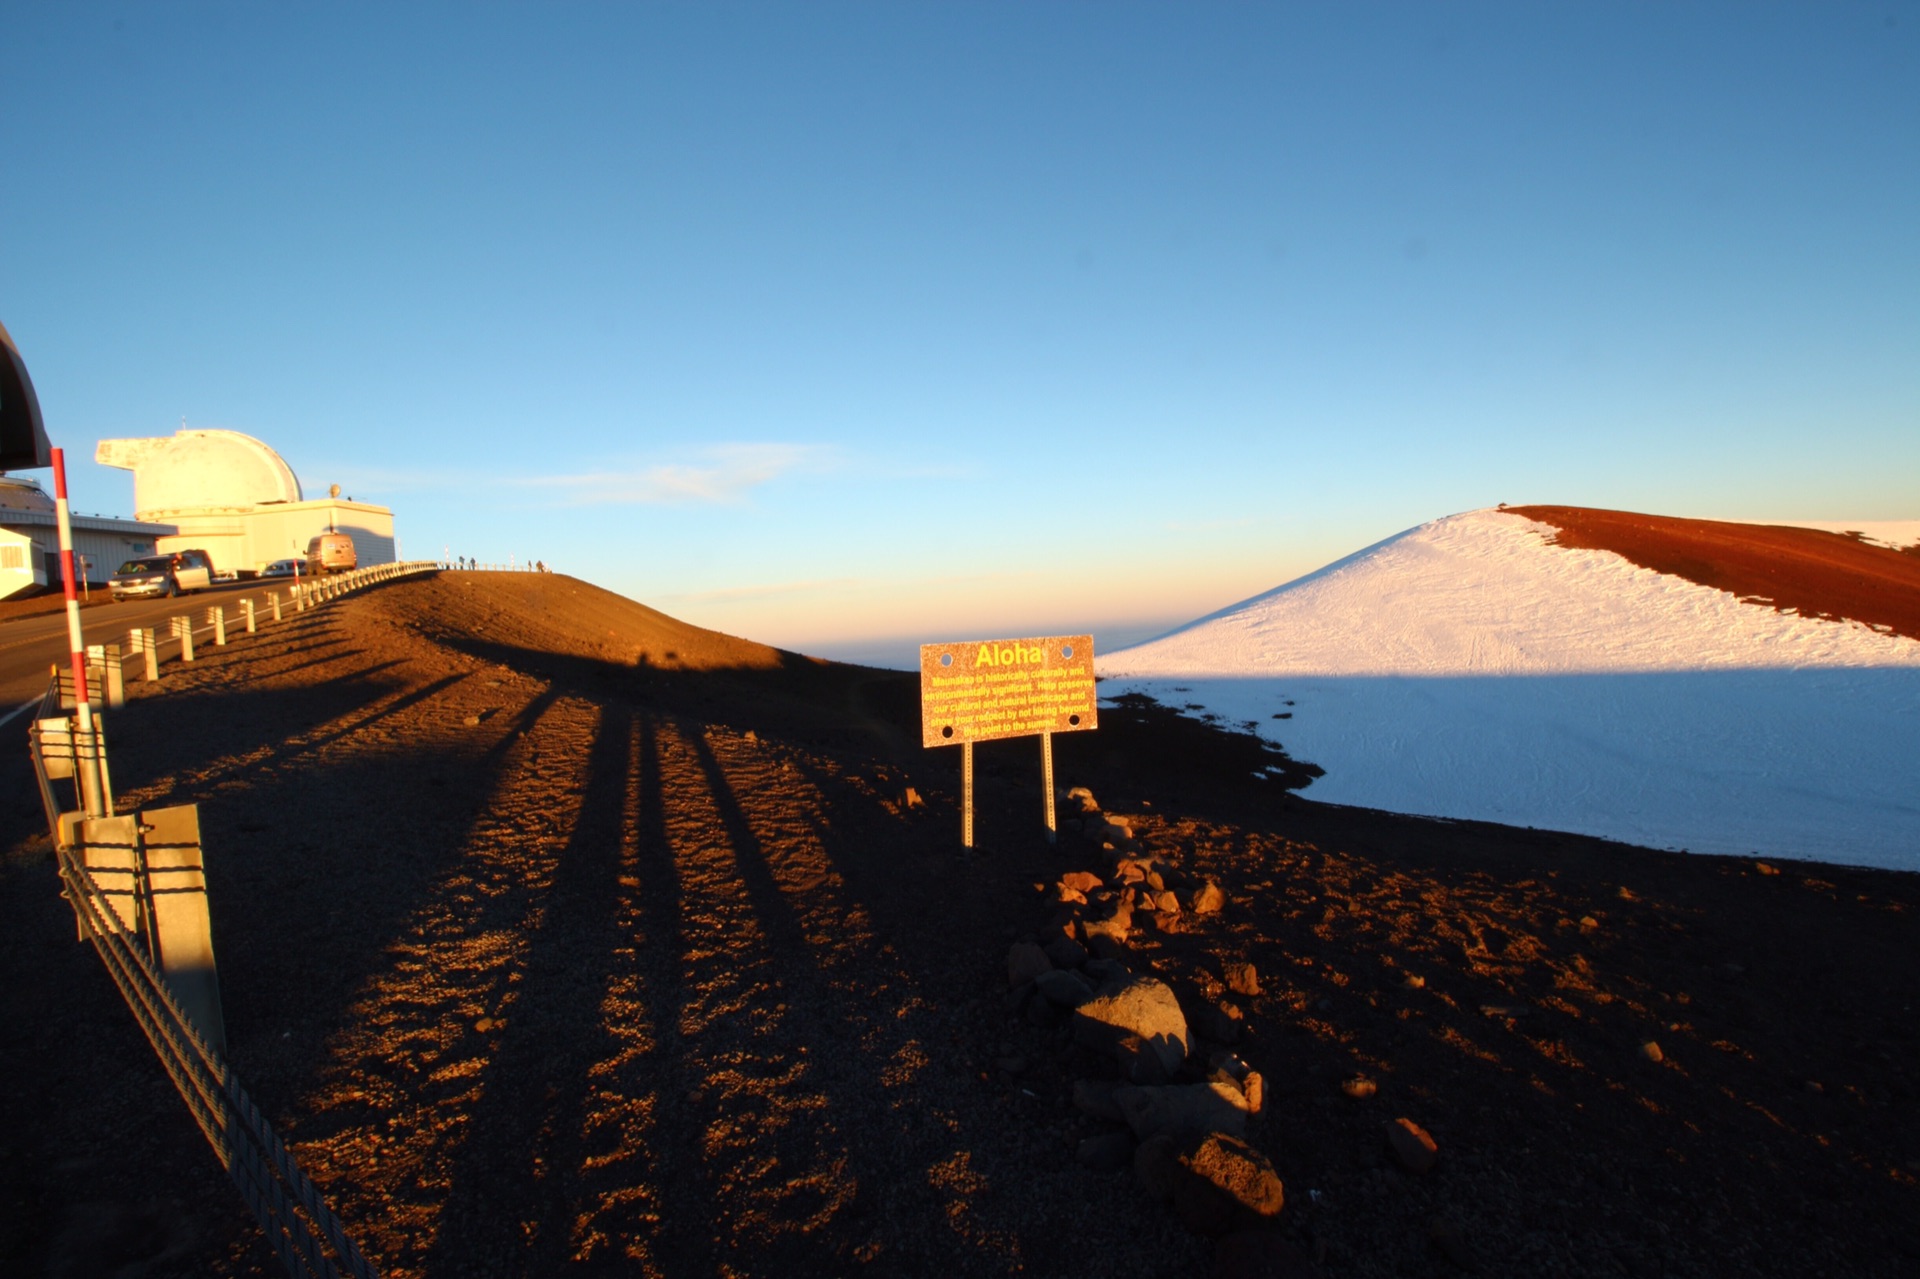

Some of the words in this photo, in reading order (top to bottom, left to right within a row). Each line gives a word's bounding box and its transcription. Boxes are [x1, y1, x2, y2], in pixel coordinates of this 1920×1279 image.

[976, 643, 1041, 667] Aloha
[976, 674, 984, 683] is
[986, 669, 1029, 682] historically,
[1031, 667, 1068, 678] culturally
[1070, 665, 1085, 676] and
[924, 686, 990, 702] environmentally
[992, 683, 1033, 697] significant.
[1037, 681, 1056, 691] Help
[1058, 680, 1093, 691] preserve
[934, 704, 948, 714] our
[950, 699, 981, 712] cultural
[983, 698, 998, 709] and
[1000, 695, 1026, 707] natural
[1028, 693, 1068, 704] landscape
[1070, 691, 1086, 701] and
[931, 717, 954, 728] show
[955, 715, 974, 726] your
[976, 711, 1005, 722] respect
[1007, 709, 1017, 720] by
[1019, 707, 1031, 717] not
[1033, 705, 1057, 717] hiking
[1059, 702, 1089, 715] beyond
[963, 726, 979, 737] this
[981, 724, 1001, 736] point
[1003, 723, 1011, 732] to
[1013, 720, 1025, 731] the
[1027, 717, 1057, 730] summit.
